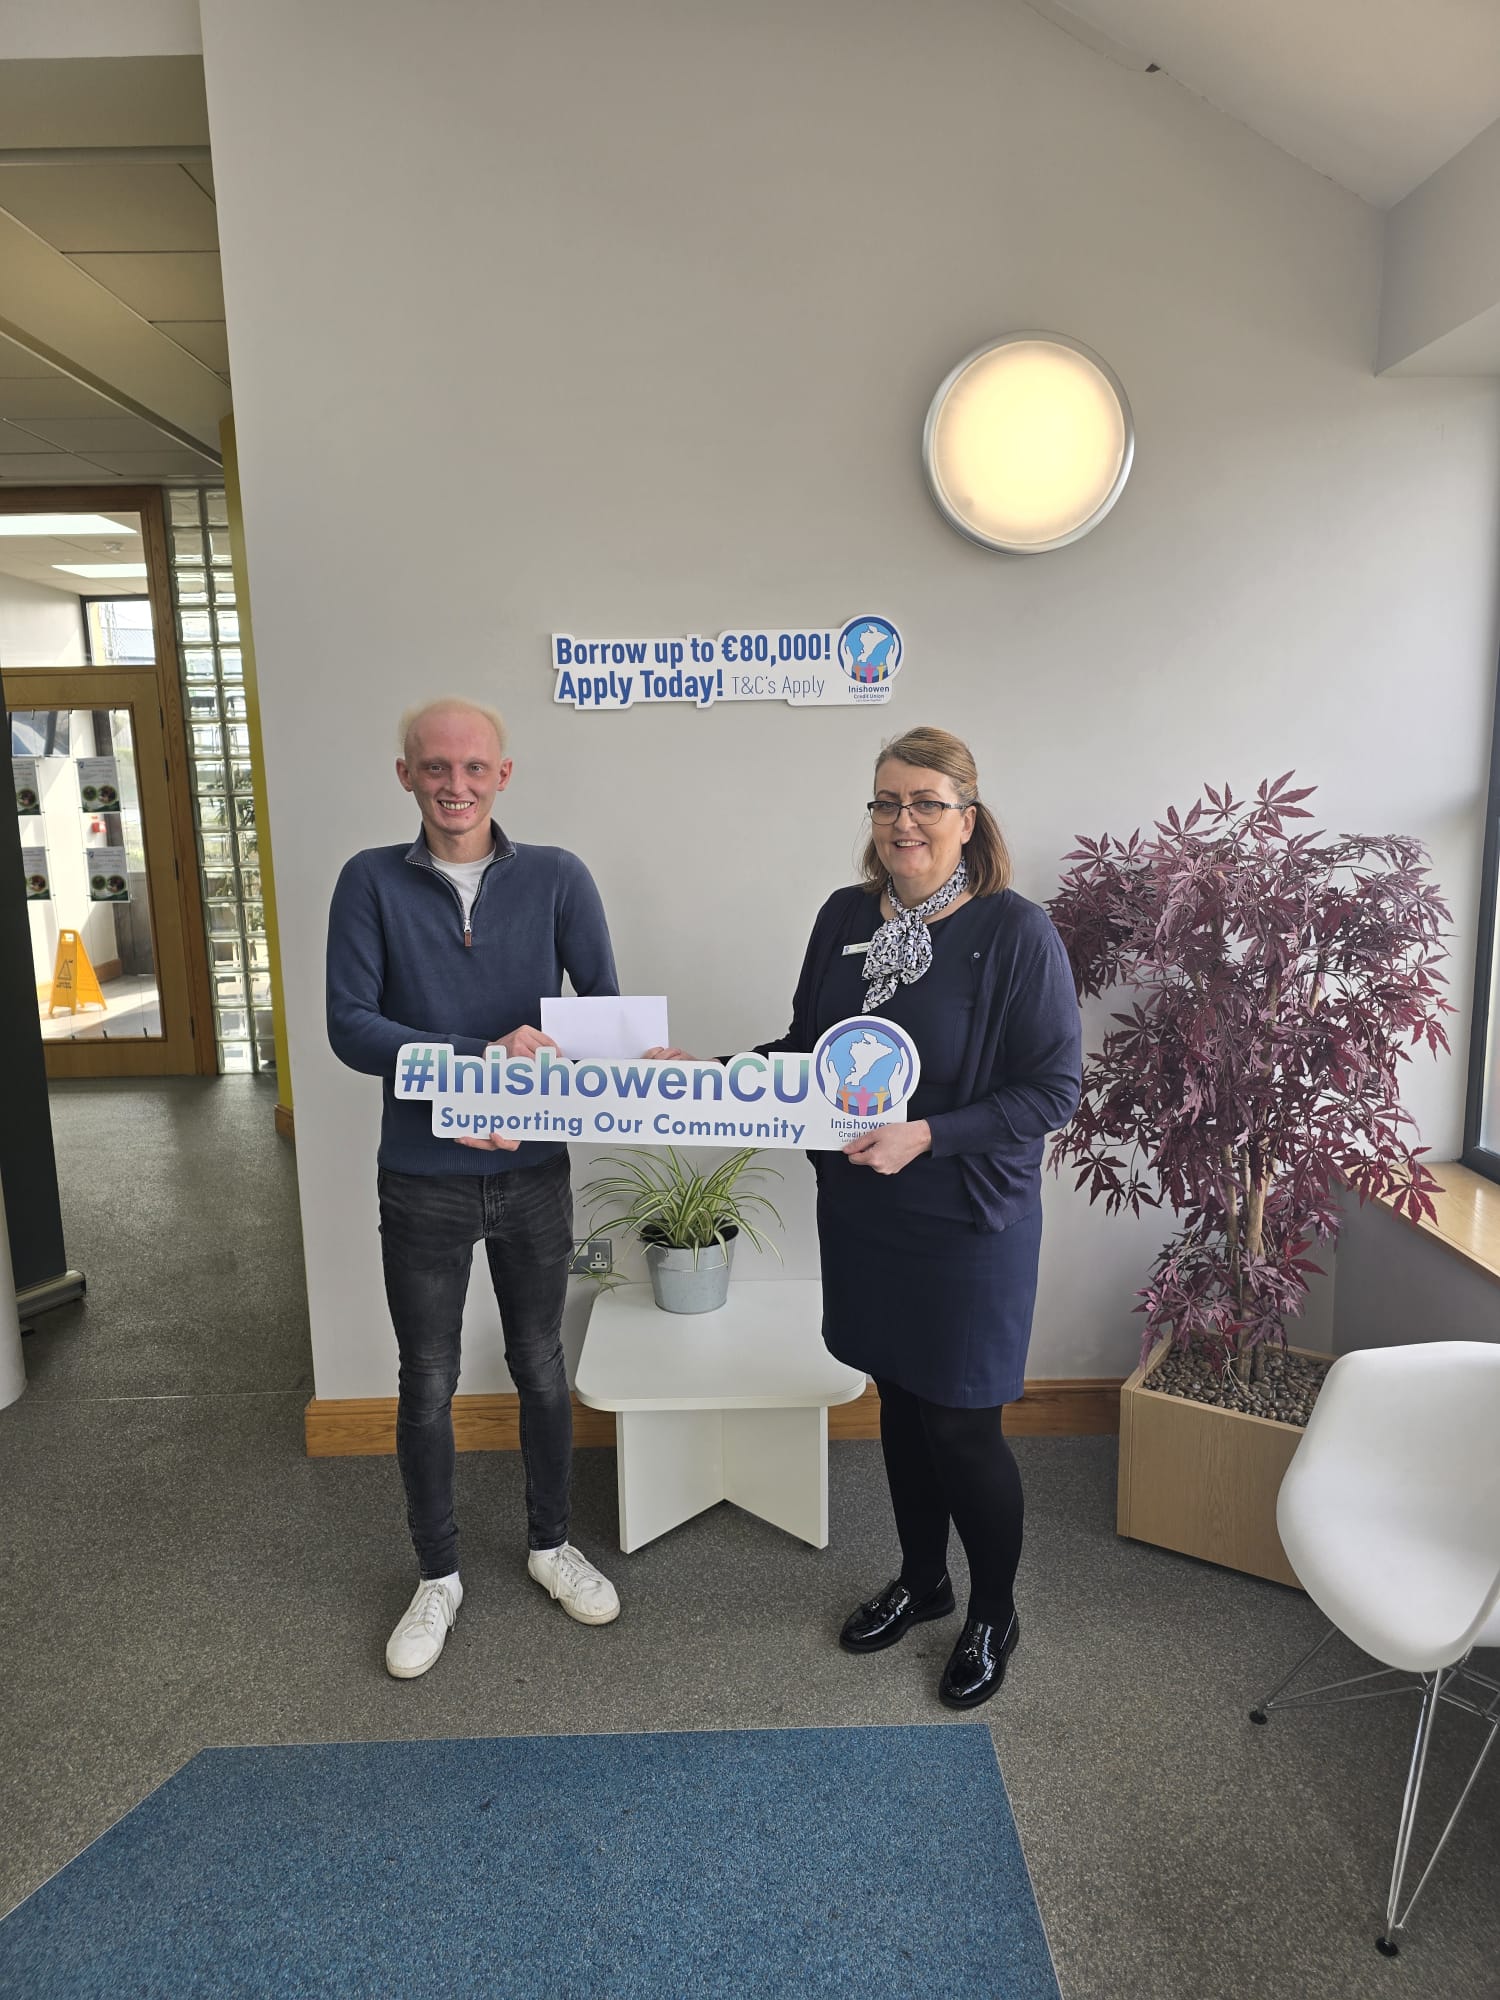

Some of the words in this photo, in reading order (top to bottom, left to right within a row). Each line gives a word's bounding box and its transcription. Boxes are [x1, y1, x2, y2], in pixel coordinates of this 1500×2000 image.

[556, 637, 647, 665] Borrow
[654, 641, 684, 670] up
[690, 637, 715, 663] to
[721, 633, 831, 667] €80,000!
[558, 670, 633, 705] Apply
[639, 668, 724, 704] Today!
[731, 675, 776, 695] T&C's
[782, 674, 825, 699] Apply
[848, 685, 890, 693] Inishowen
[401, 1047, 809, 1104] #InishowenCU
[440, 1106, 583, 1137] Supporting
[594, 1111, 643, 1134] Our
[653, 1113, 806, 1144] Community
[831, 1118, 892, 1130] Inishowe
